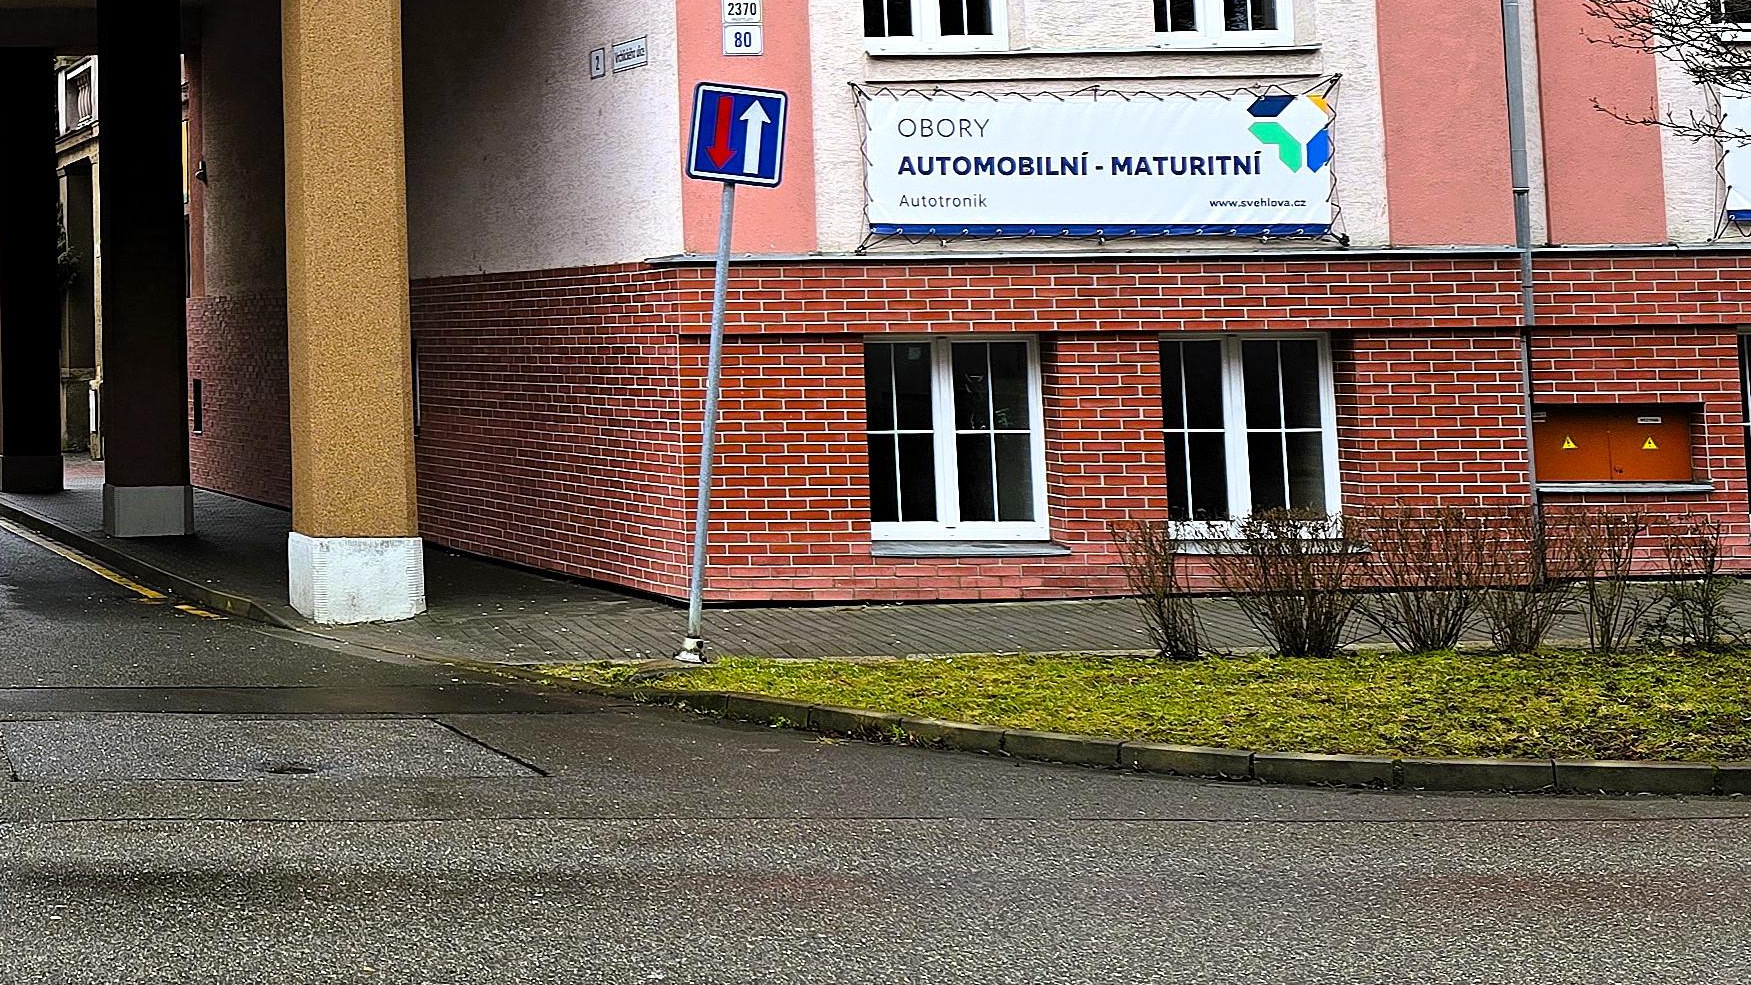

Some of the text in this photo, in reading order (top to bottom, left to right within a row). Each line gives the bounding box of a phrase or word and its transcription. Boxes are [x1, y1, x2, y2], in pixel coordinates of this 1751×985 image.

[727, 2, 757, 16] 2370
[734, 31, 752, 48] 80
[897, 117, 990, 139] OBORY
[897, 151, 1090, 177] AUTOMOBILNÍ
[1111, 150, 1262, 176] MATURITNÍ
[899, 193, 988, 208] Autotronik
[1209, 197, 1307, 208] www.svehlova.cz
